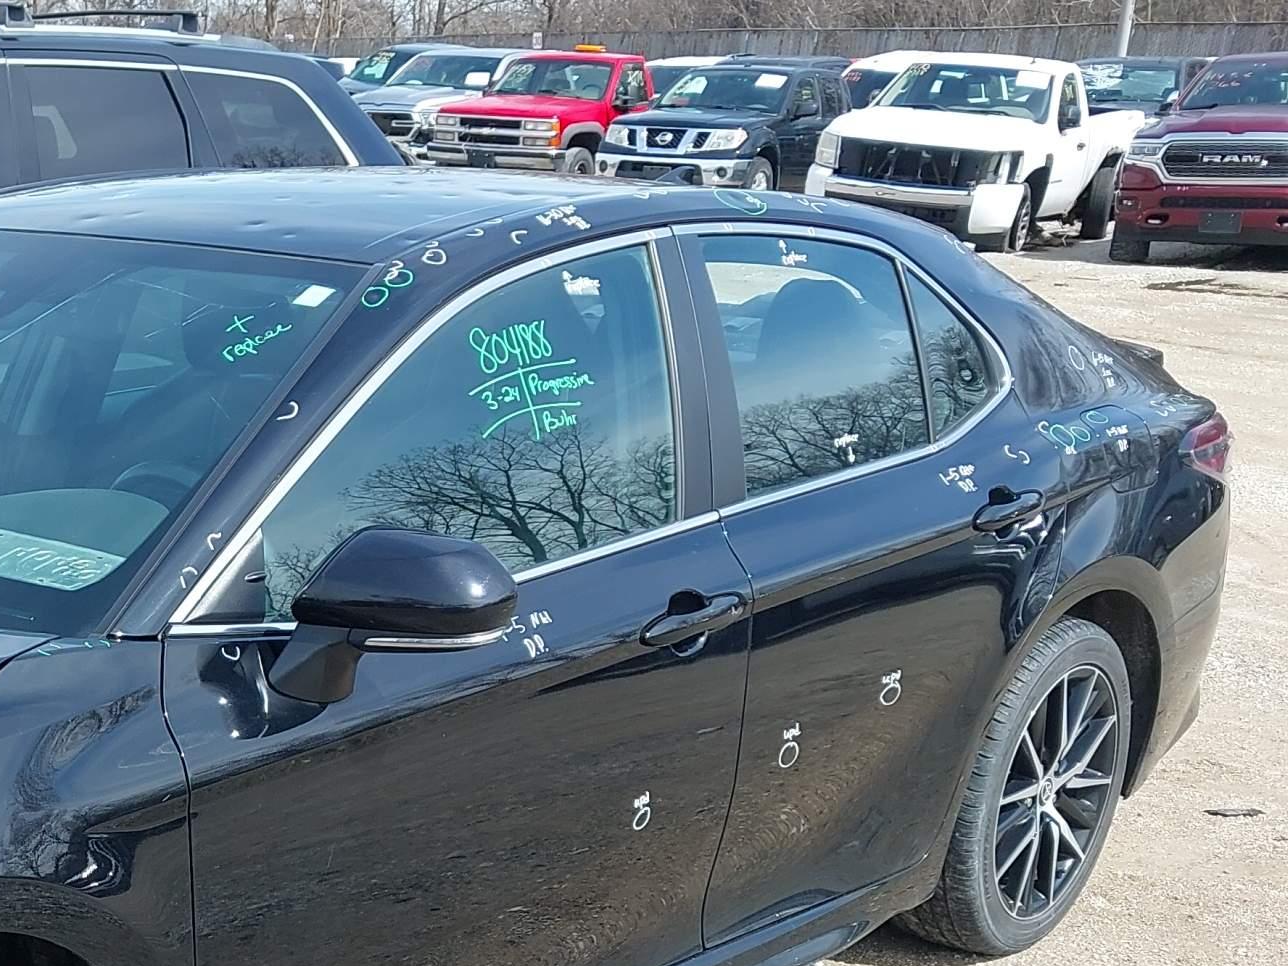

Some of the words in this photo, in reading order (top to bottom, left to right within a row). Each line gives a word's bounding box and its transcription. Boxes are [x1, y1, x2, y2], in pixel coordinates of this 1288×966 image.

[1202, 154, 1262, 164] RAM
[469, 319, 553, 374] 804188
[481, 386, 521, 410] 3-24
